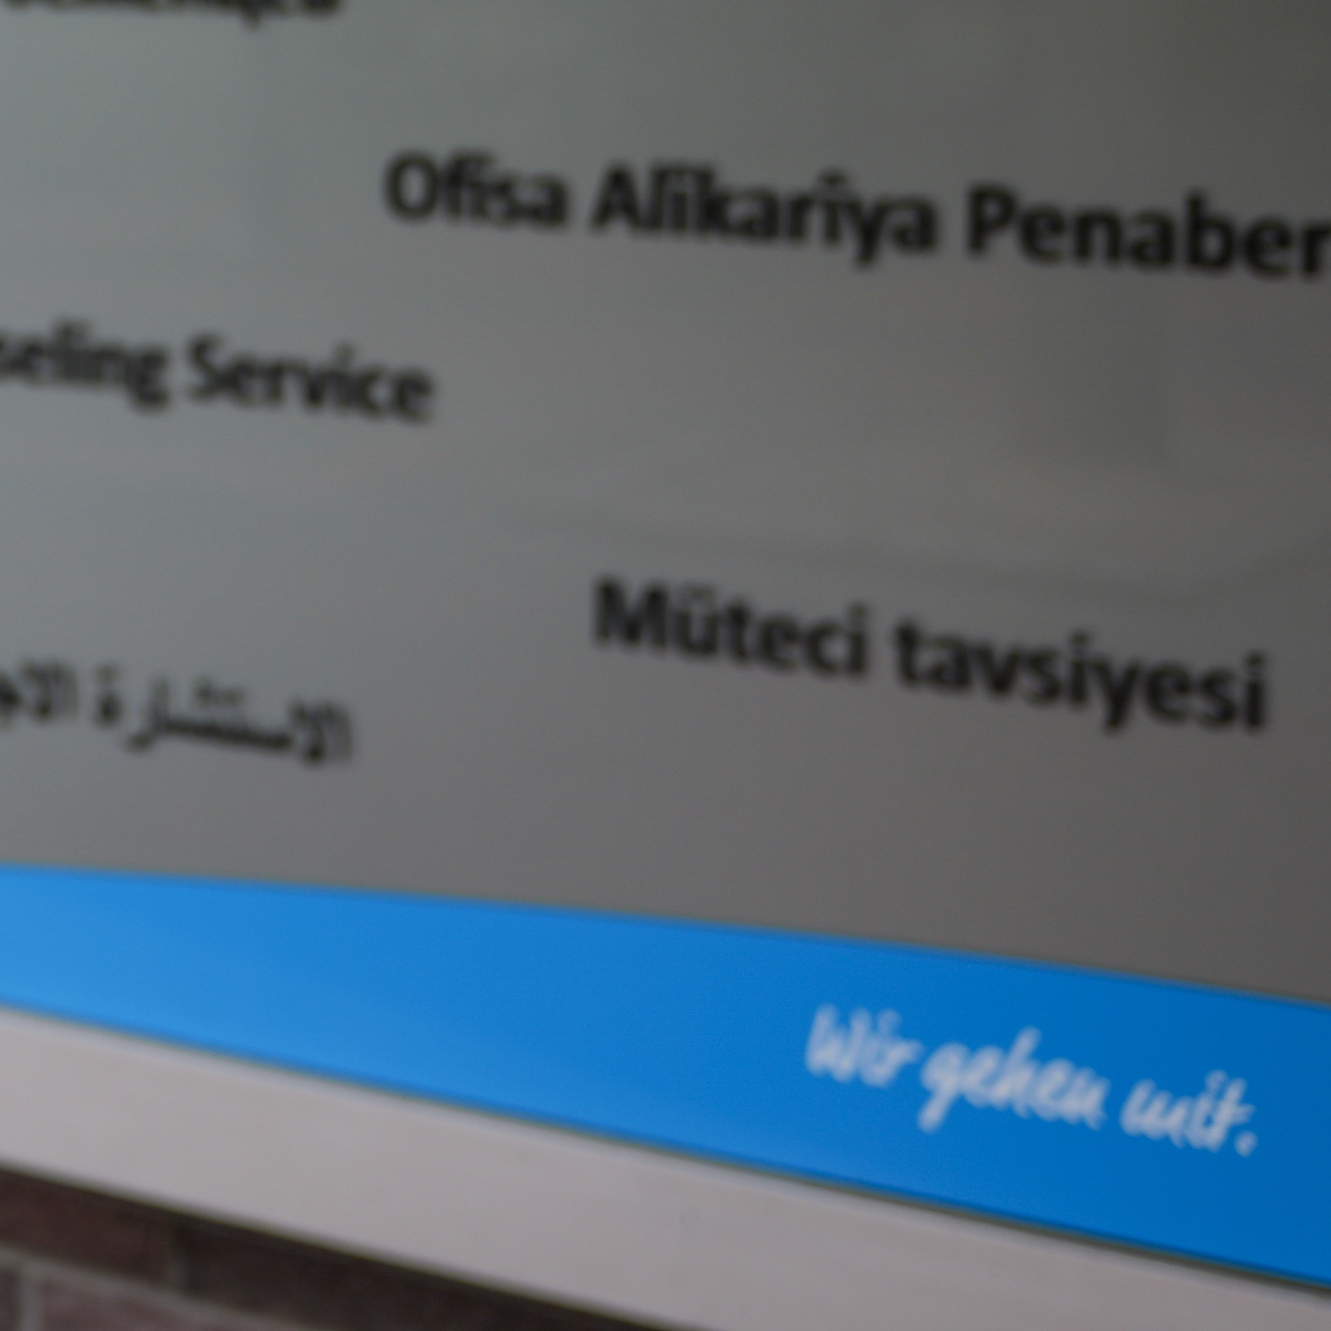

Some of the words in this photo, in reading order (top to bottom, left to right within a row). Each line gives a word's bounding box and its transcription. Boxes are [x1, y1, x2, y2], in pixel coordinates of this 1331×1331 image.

[965, 182, 1331, 283] Penaber
[184, 333, 436, 425] Service
[593, 575, 873, 681] Müteci
[892, 619, 1272, 736] tavsiyesi
[805, 1005, 924, 1089] Wir
[915, 1026, 1110, 1133] gehen
[1120, 1070, 1258, 1156] mit.
